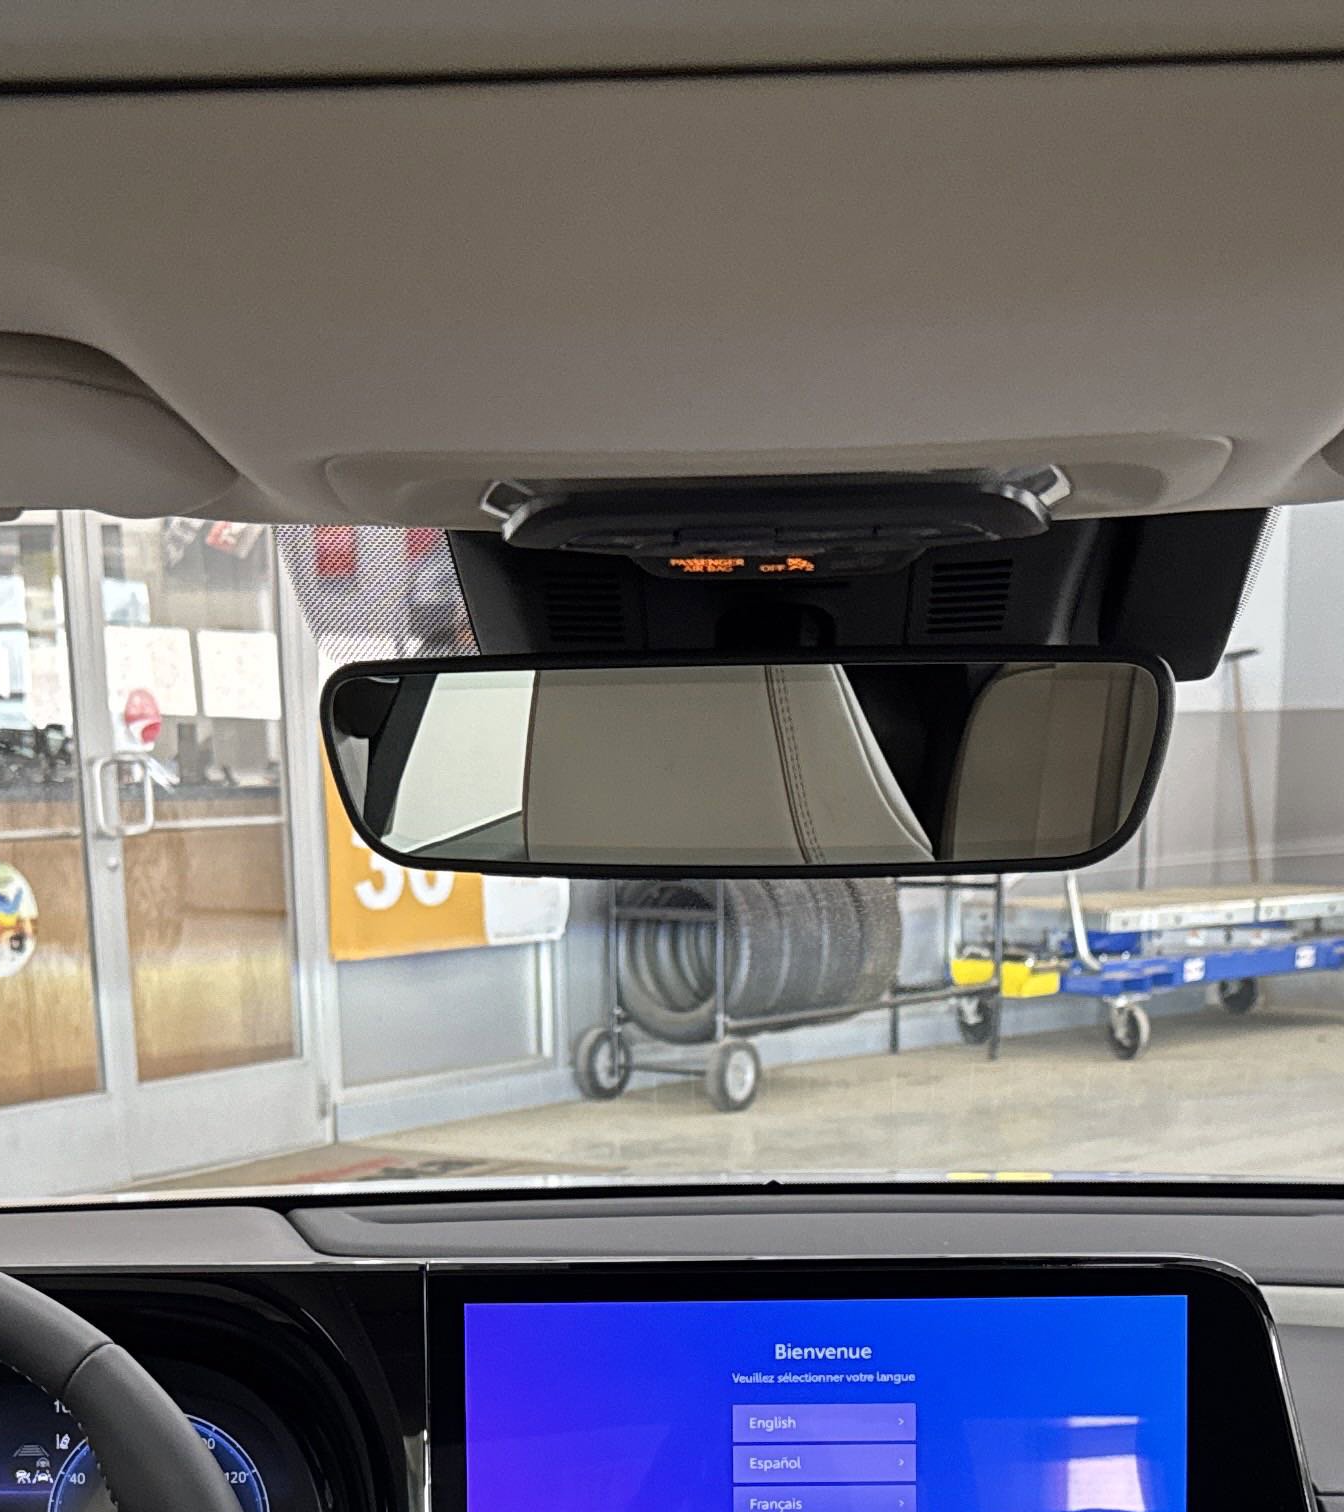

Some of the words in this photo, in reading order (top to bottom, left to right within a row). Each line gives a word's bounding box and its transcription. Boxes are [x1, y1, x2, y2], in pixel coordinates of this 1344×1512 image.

[774, 1343, 873, 1360] Bienvenue
[732, 1372, 774, 1383] Veuillez
[777, 1372, 843, 1383] sélectionner
[846, 1373, 874, 1382] votre
[876, 1371, 916, 1384] langue
[749, 1416, 797, 1432] English
[749, 1456, 802, 1472] Español
[69, 1472, 86, 1485] 40
[749, 1497, 803, 1512] Français
